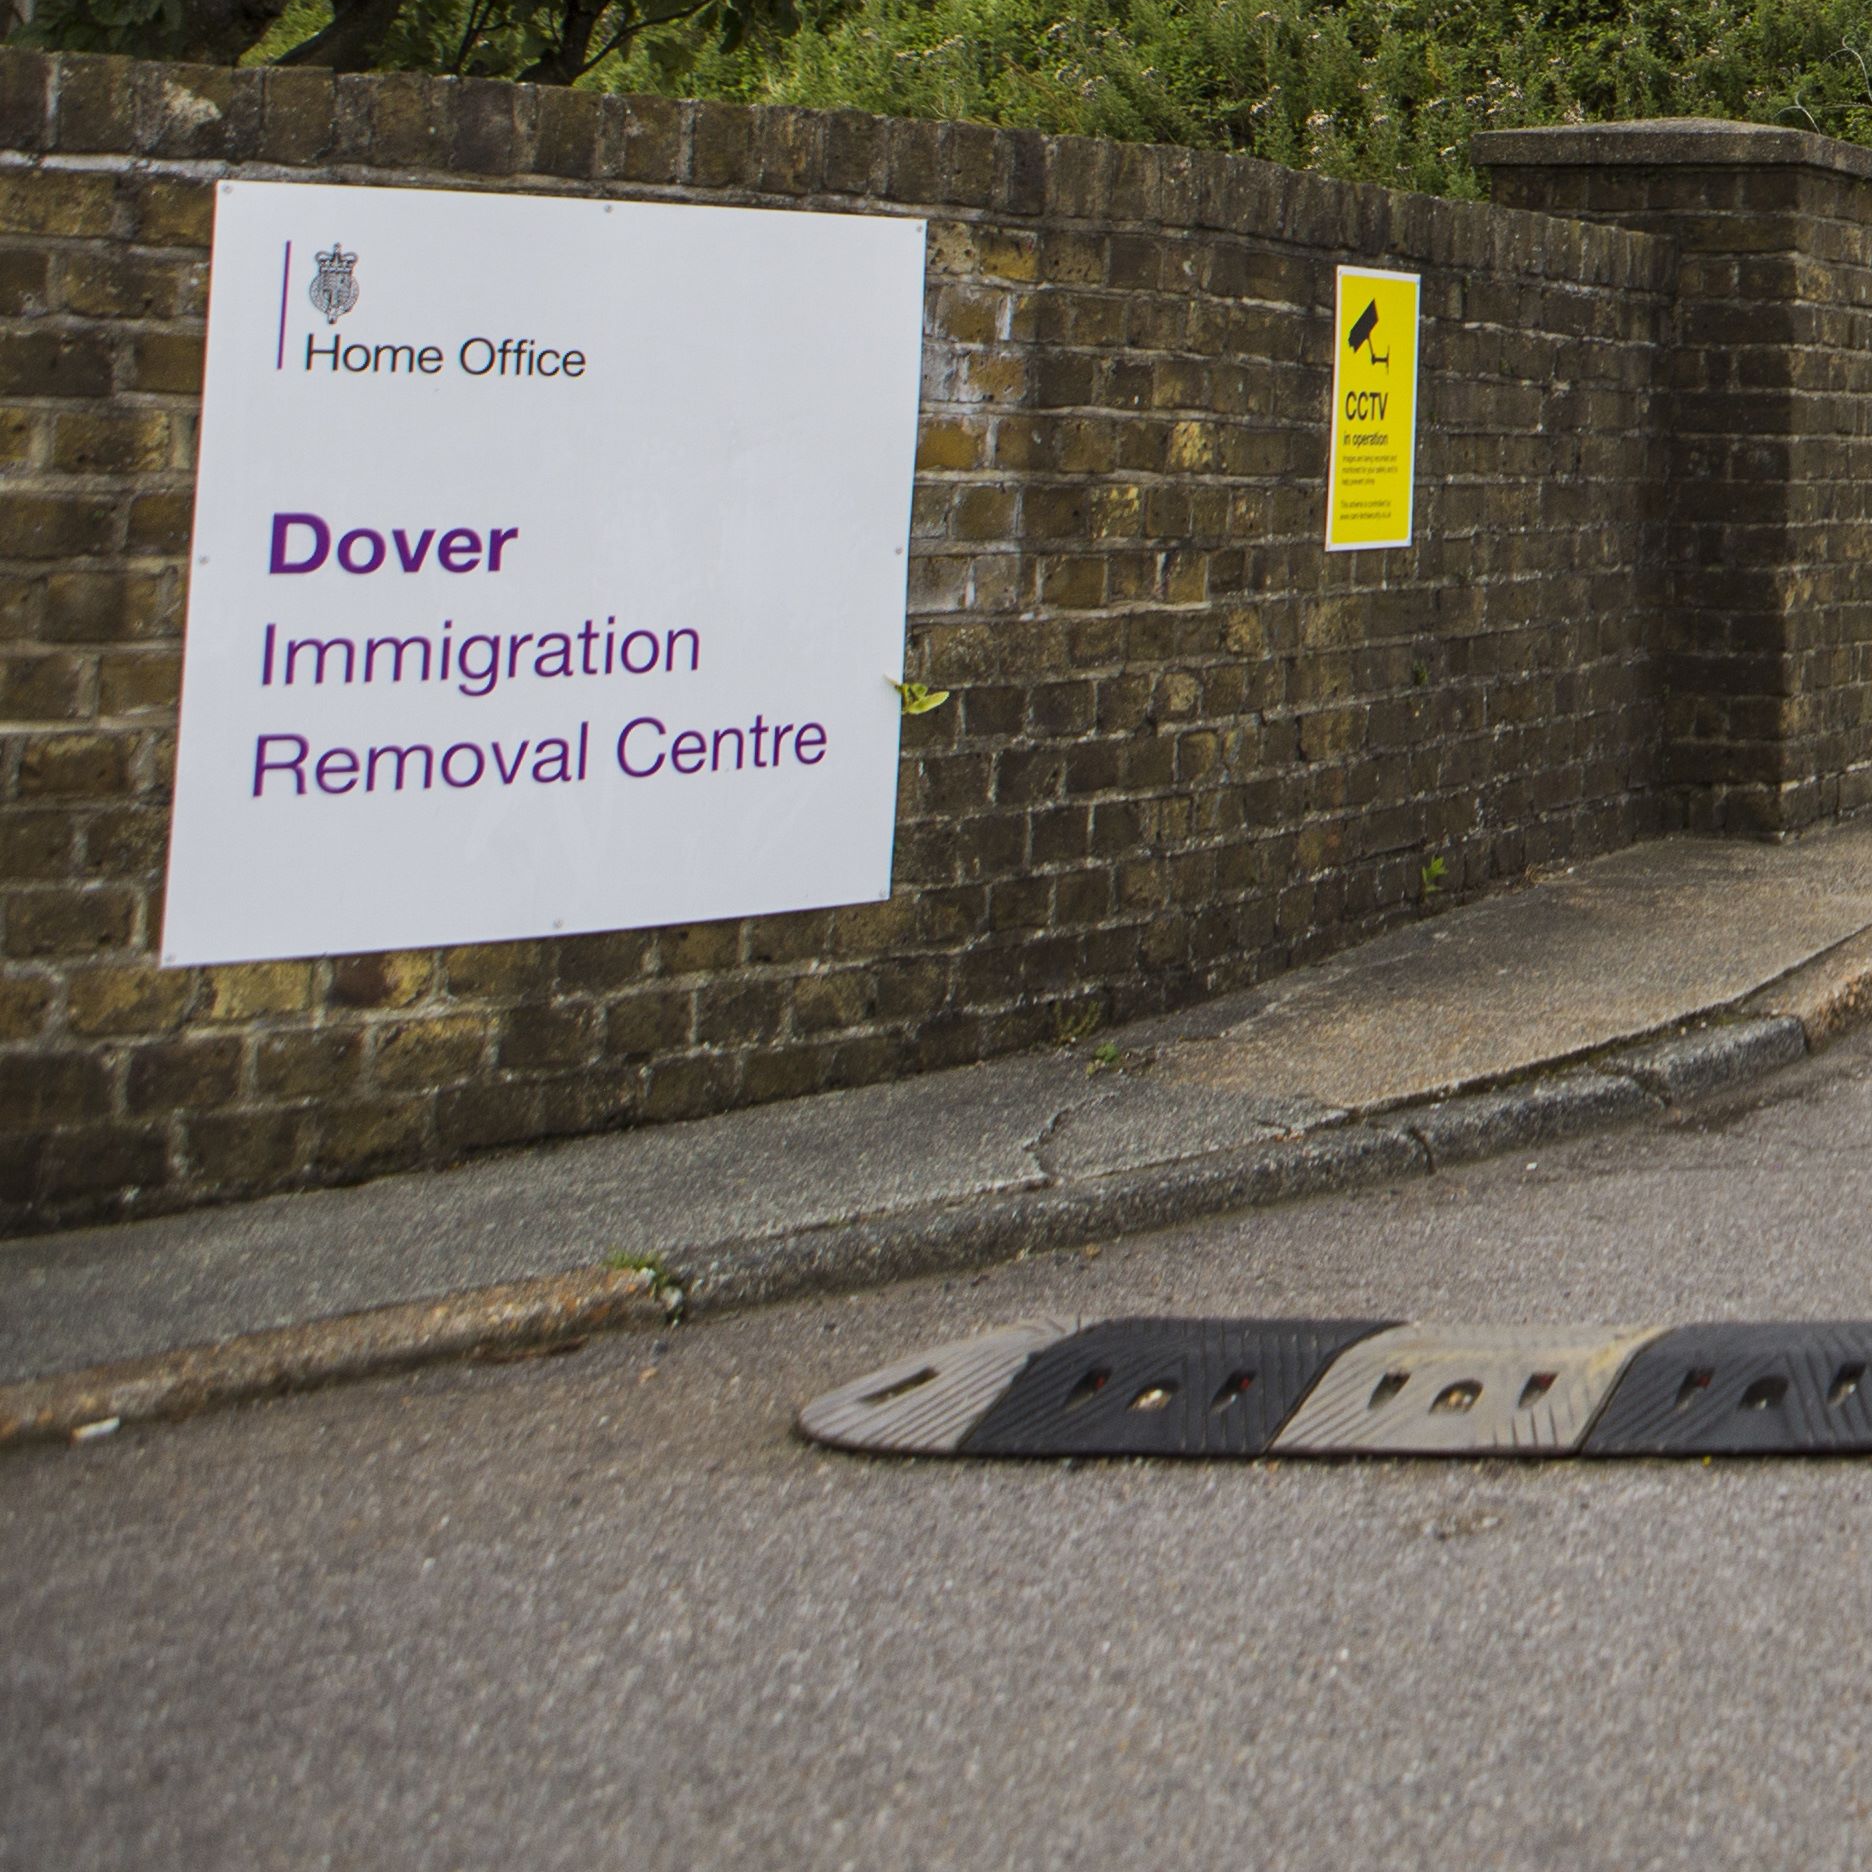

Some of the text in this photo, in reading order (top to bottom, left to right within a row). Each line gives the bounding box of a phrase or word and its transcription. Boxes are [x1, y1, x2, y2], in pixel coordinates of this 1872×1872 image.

[306, 334, 587, 379] Home Office
[1345, 391, 1388, 421] CCTV
[1343, 431, 1388, 449] in operation
[270, 514, 519, 576] Dover
[263, 617, 700, 698] Immigration
[254, 716, 828, 798] Removal Centre
